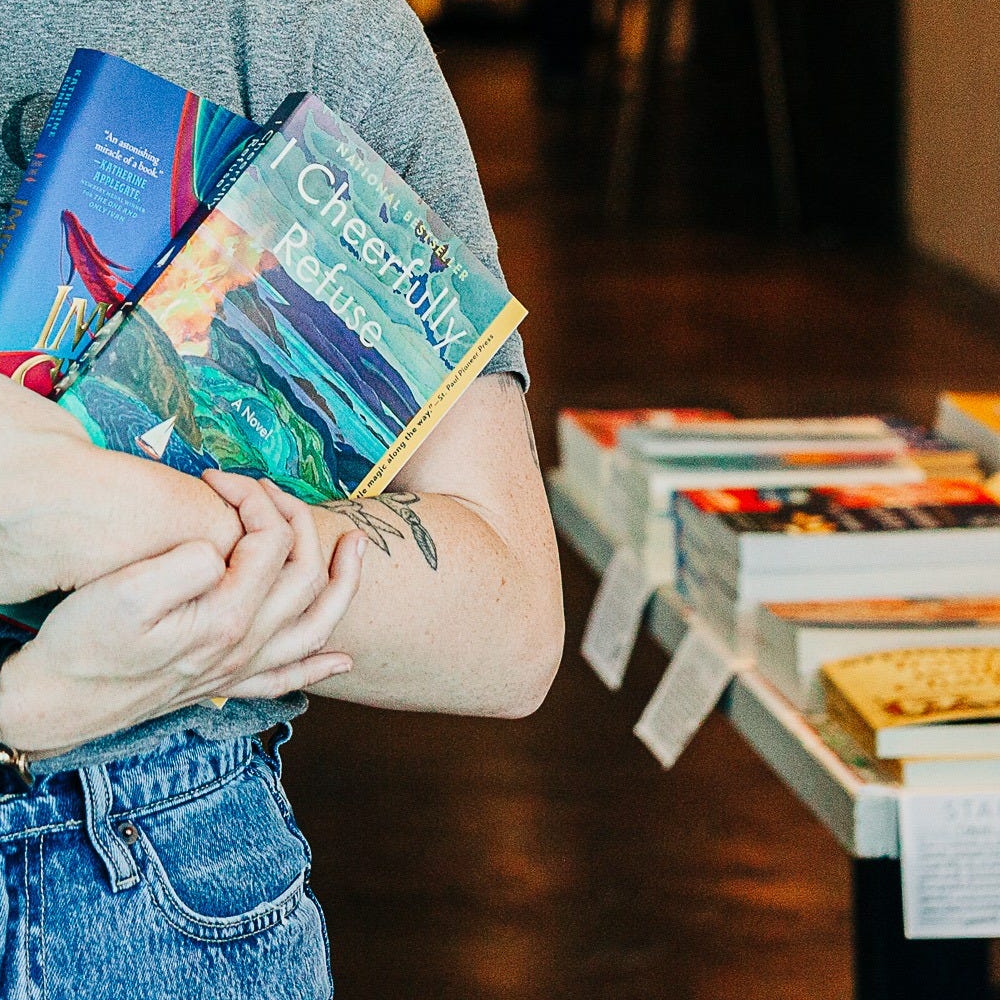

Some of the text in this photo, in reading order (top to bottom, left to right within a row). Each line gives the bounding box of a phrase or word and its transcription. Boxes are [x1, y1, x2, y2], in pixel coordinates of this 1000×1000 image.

[46, 76, 72, 130] RUNDELL
[49, 68, 81, 139] KATHERINE
[94, 143, 123, 162] miracle
[122, 156, 135, 166] of
[118, 140, 160, 167] astonishing
[270, 136, 468, 351] I Cheerfully
[335, 142, 470, 282] NATIONAL BESTSELLER
[273, 221, 383, 349] Refuse
[230, 396, 274, 441] A Novel
[367, 464, 387, 488] magic
[386, 440, 407, 465] along
[405, 426, 418, 442] the
[446, 374, 460, 391] Paul
[458, 352, 479, 376] Pioneer
[478, 333, 495, 353] Press
